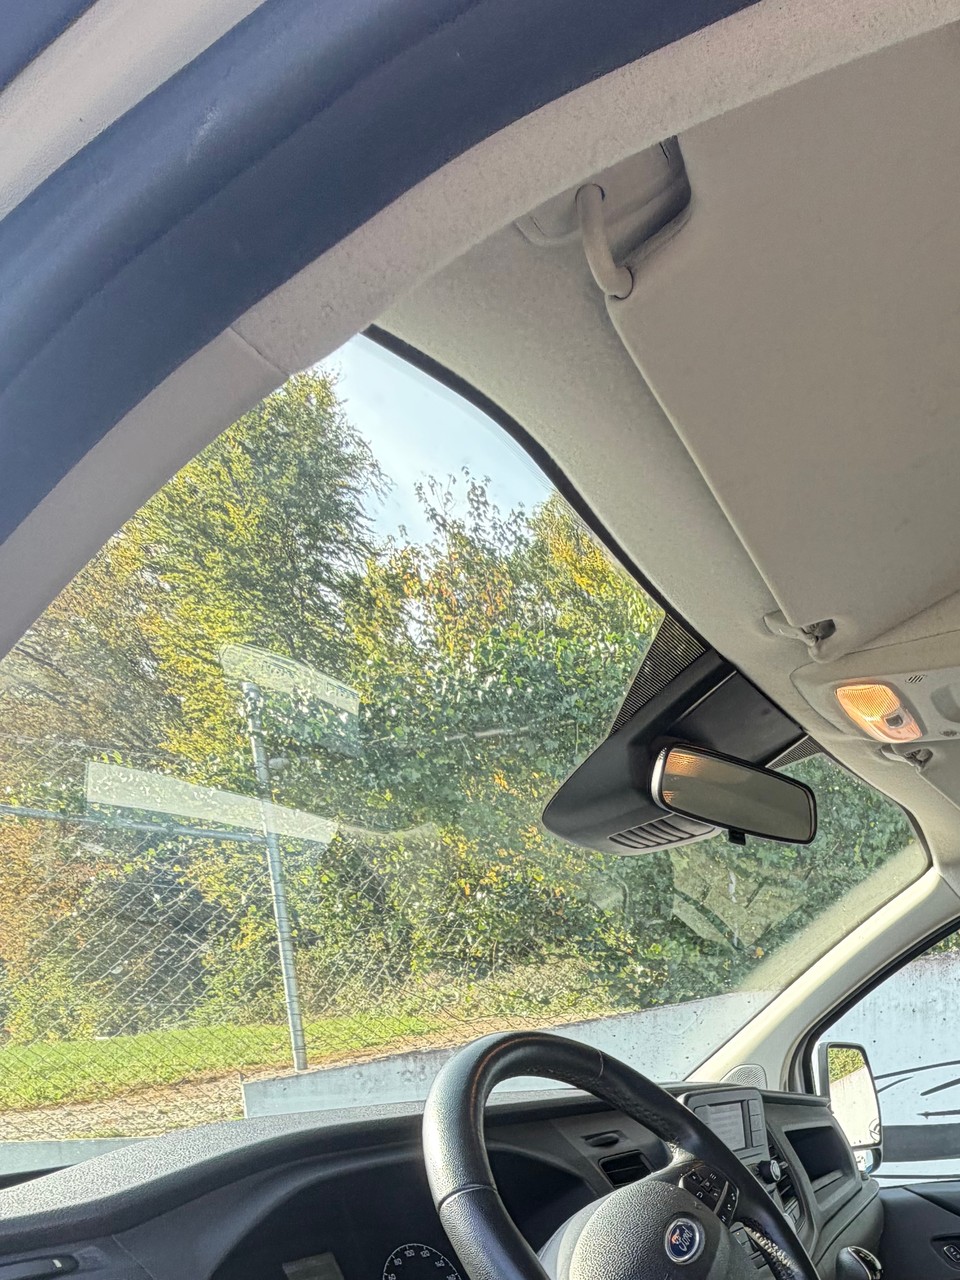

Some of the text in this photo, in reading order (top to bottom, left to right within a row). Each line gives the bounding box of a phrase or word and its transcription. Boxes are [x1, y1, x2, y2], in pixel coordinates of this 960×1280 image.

[671, 1226, 693, 1251] Ford
[404, 1249, 415, 1257] 100
[420, 1249, 430, 1258] 120
